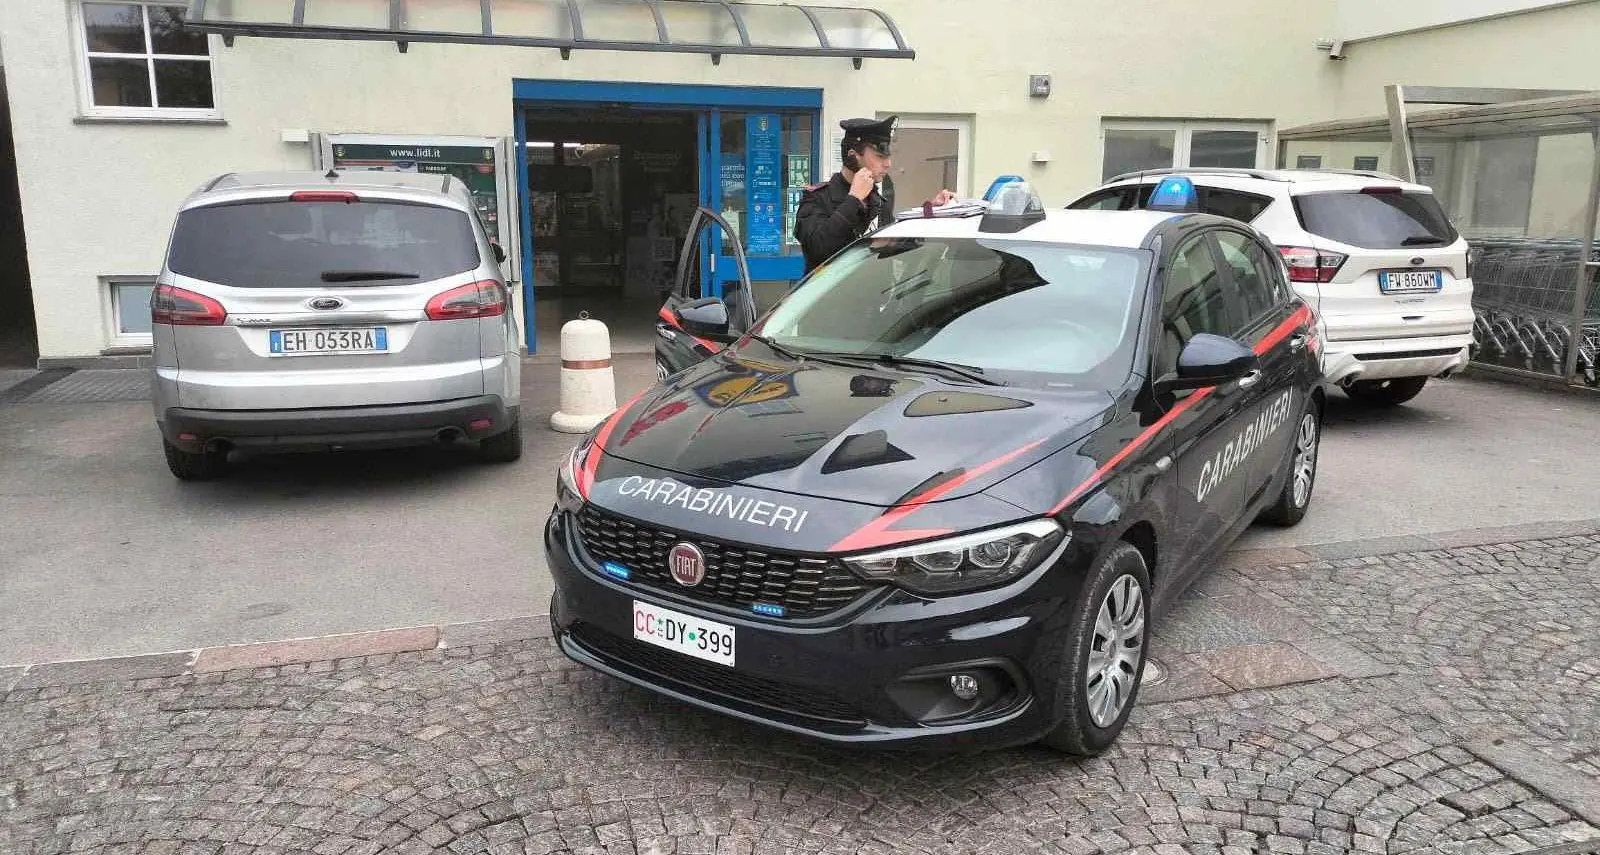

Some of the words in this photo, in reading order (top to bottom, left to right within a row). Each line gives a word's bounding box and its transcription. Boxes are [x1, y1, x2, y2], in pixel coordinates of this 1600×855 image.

[389, 147, 441, 159] www.lidl.it
[1387, 272, 1401, 288] FW
[1404, 271, 1436, 288] 860WM
[283, 332, 307, 351] EH
[315, 330, 374, 350] 053RA
[1196, 385, 1293, 503] CARABINIERI
[618, 475, 809, 533] CARABINIERI
[675, 554, 698, 578] FIAT
[635, 609, 656, 636] CC
[665, 618, 687, 645] DY
[697, 627, 733, 657] 399
